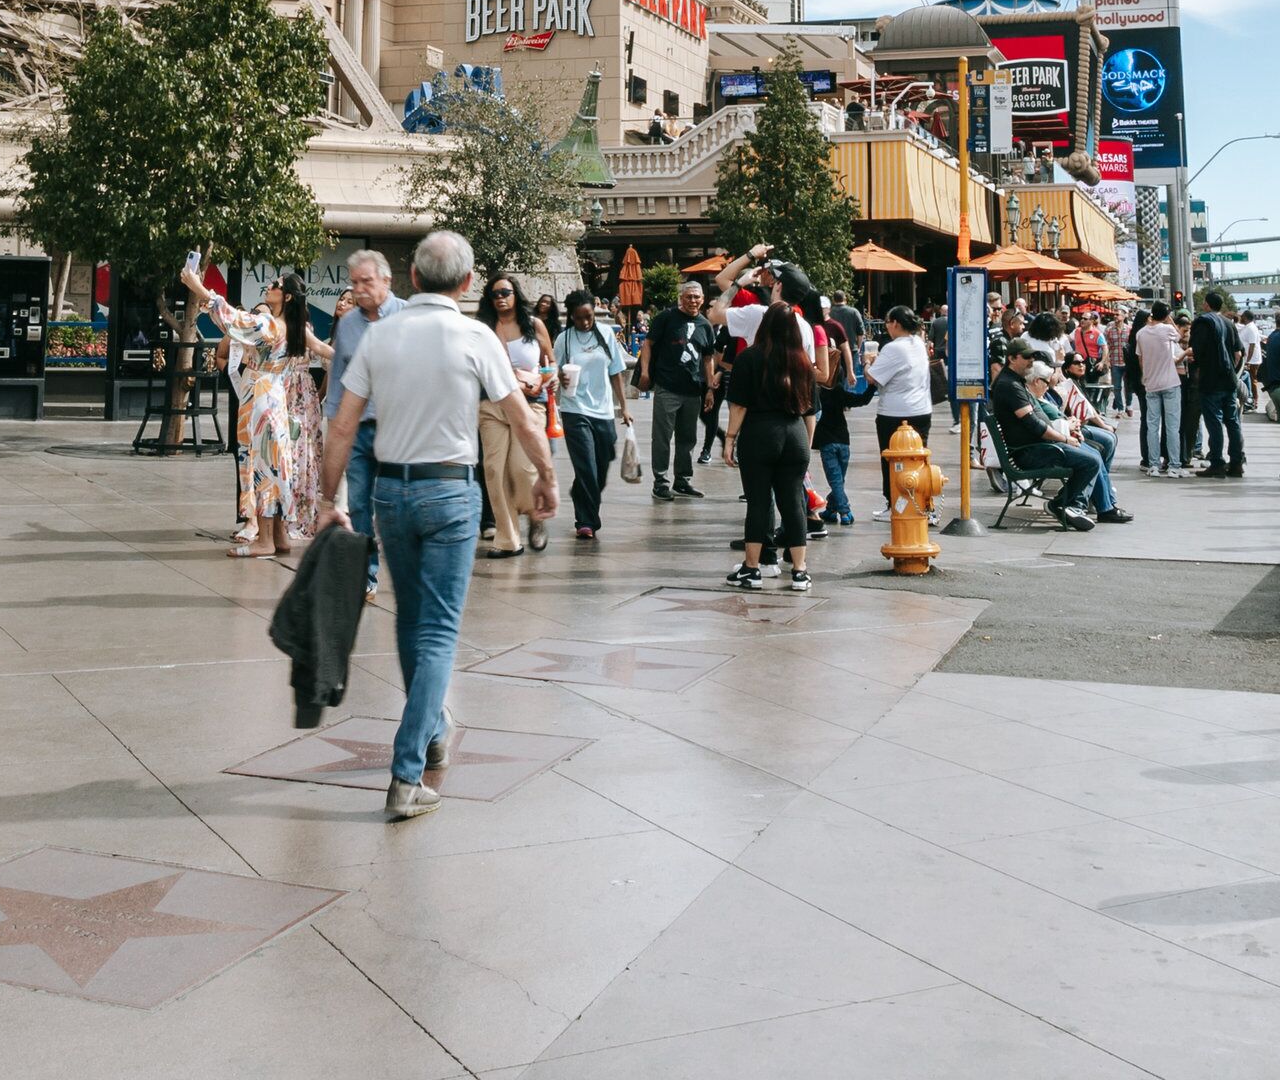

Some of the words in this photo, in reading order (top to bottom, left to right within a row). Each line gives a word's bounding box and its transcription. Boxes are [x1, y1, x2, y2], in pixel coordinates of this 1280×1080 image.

[1095, 10, 1165, 27] hollywood
[1010, 66, 1030, 87] EER
[1032, 65, 1062, 89] PARK
[1102, 69, 1166, 80] GODSMACK
[1012, 93, 1051, 102] ROOFTOP
[1011, 100, 1056, 109] AR&GRILL
[1096, 153, 1128, 164] AESARS
[1210, 253, 1233, 262] Paris
